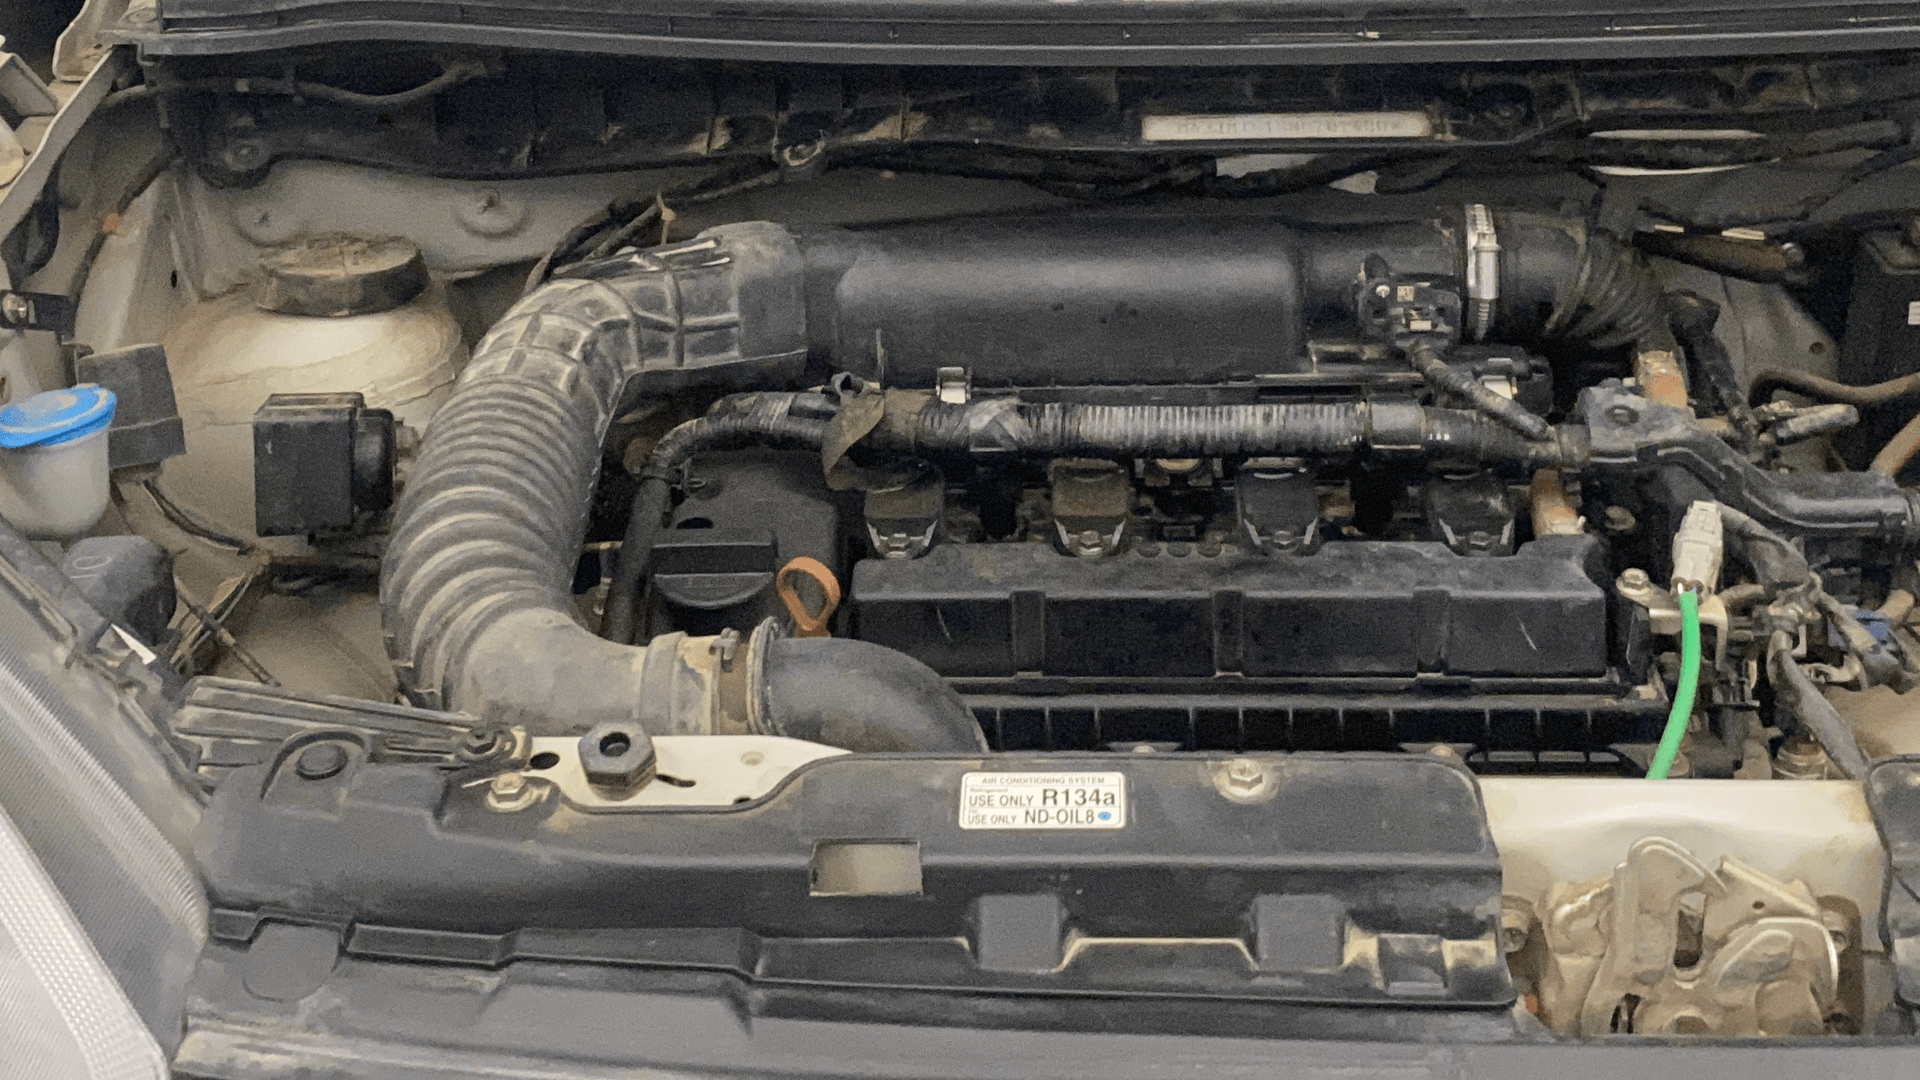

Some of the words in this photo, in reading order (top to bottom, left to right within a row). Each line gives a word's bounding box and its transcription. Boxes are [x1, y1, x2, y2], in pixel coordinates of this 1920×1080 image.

[981, 777, 997, 785] AIR
[999, 777, 1066, 785] CONDITIONING
[1068, 777, 1106, 785] SYSTEM
[968, 795, 996, 807] USE
[998, 795, 1034, 807] ONLY
[1041, 788, 1116, 806] R134a
[967, 814, 987, 825] USE
[990, 814, 1017, 825] ONLY
[1024, 808, 1095, 825] ND-OIL8
